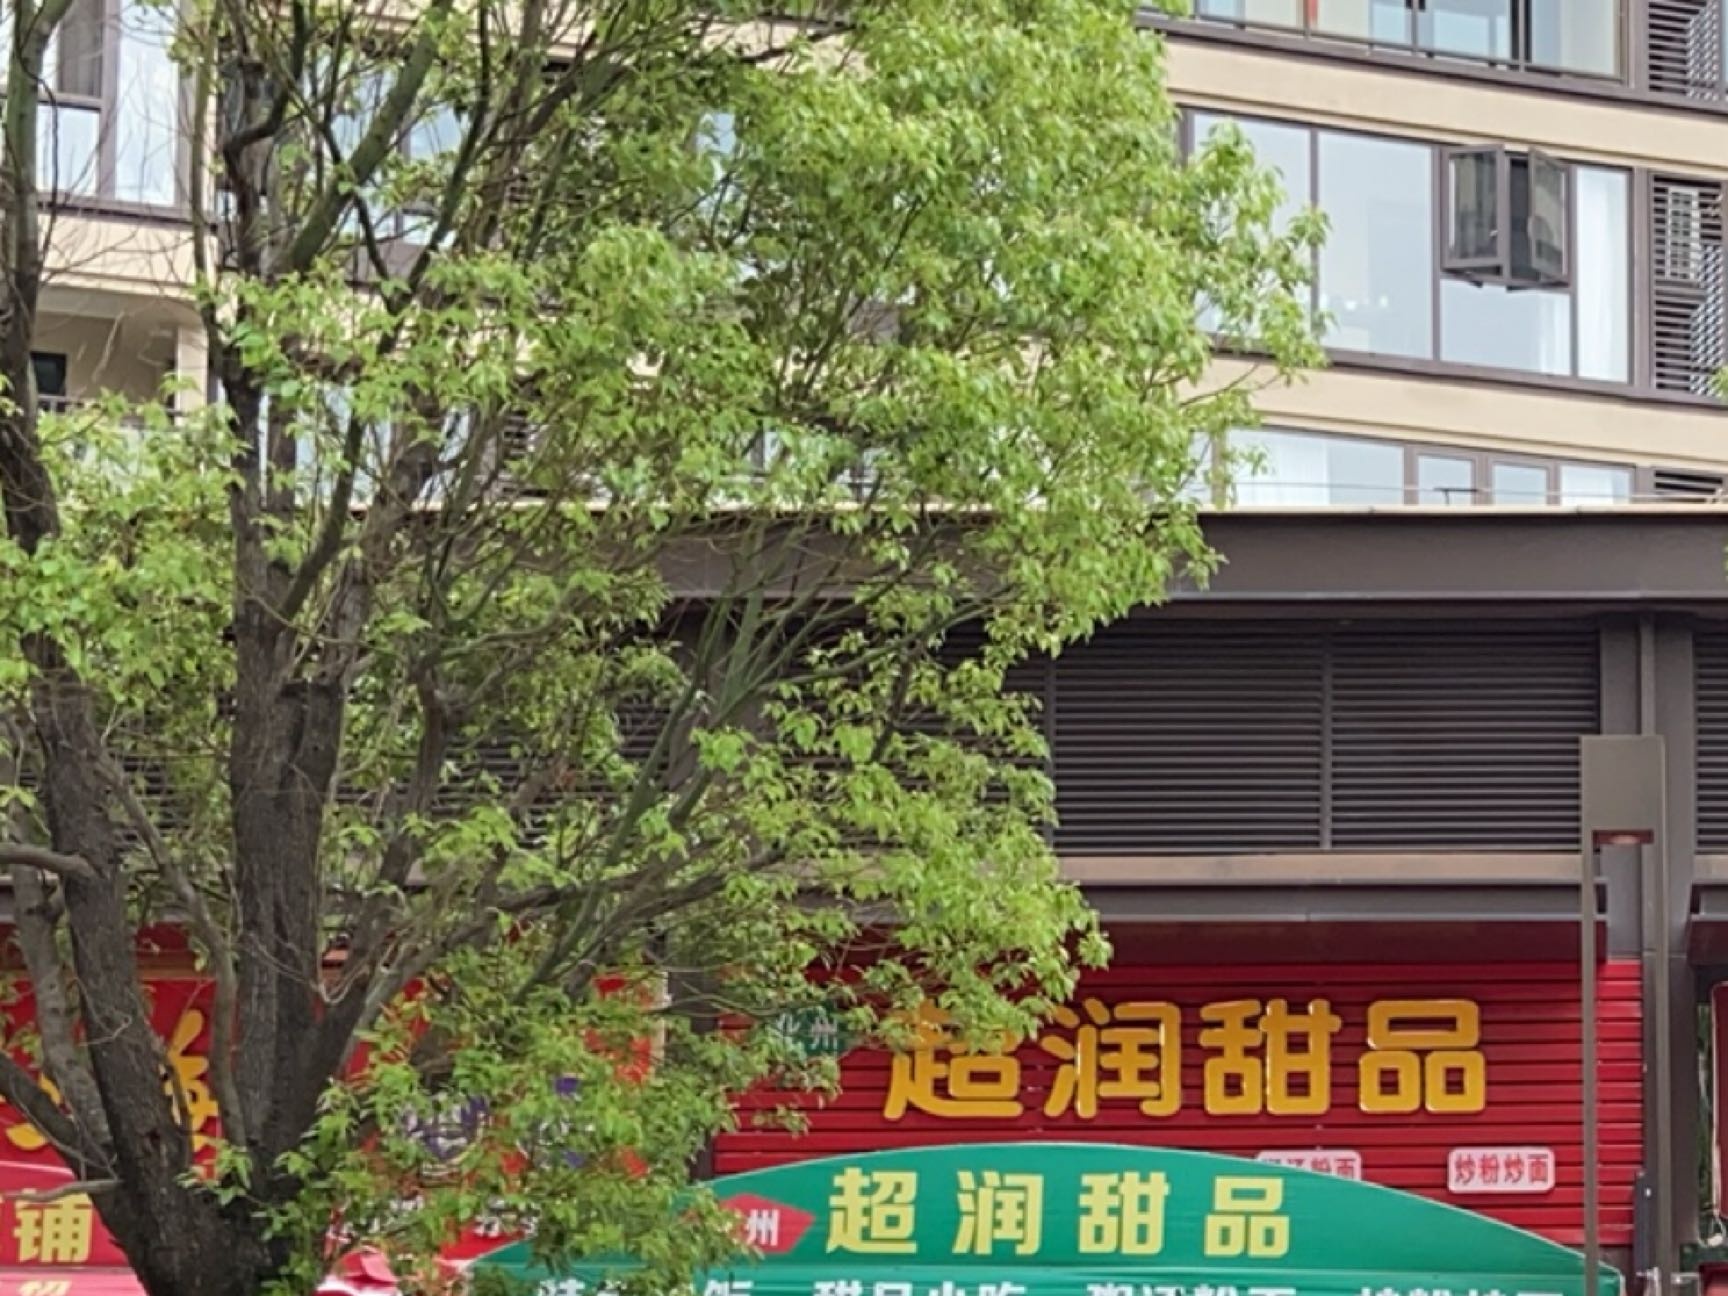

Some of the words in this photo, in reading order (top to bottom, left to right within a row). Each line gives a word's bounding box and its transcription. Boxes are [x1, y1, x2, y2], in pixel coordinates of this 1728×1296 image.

[882, 998, 1487, 1121] 超润甜品
[826, 1166, 1290, 1257] 超润甜品
[1454, 1153, 1550, 1184] 炒粉炒面
